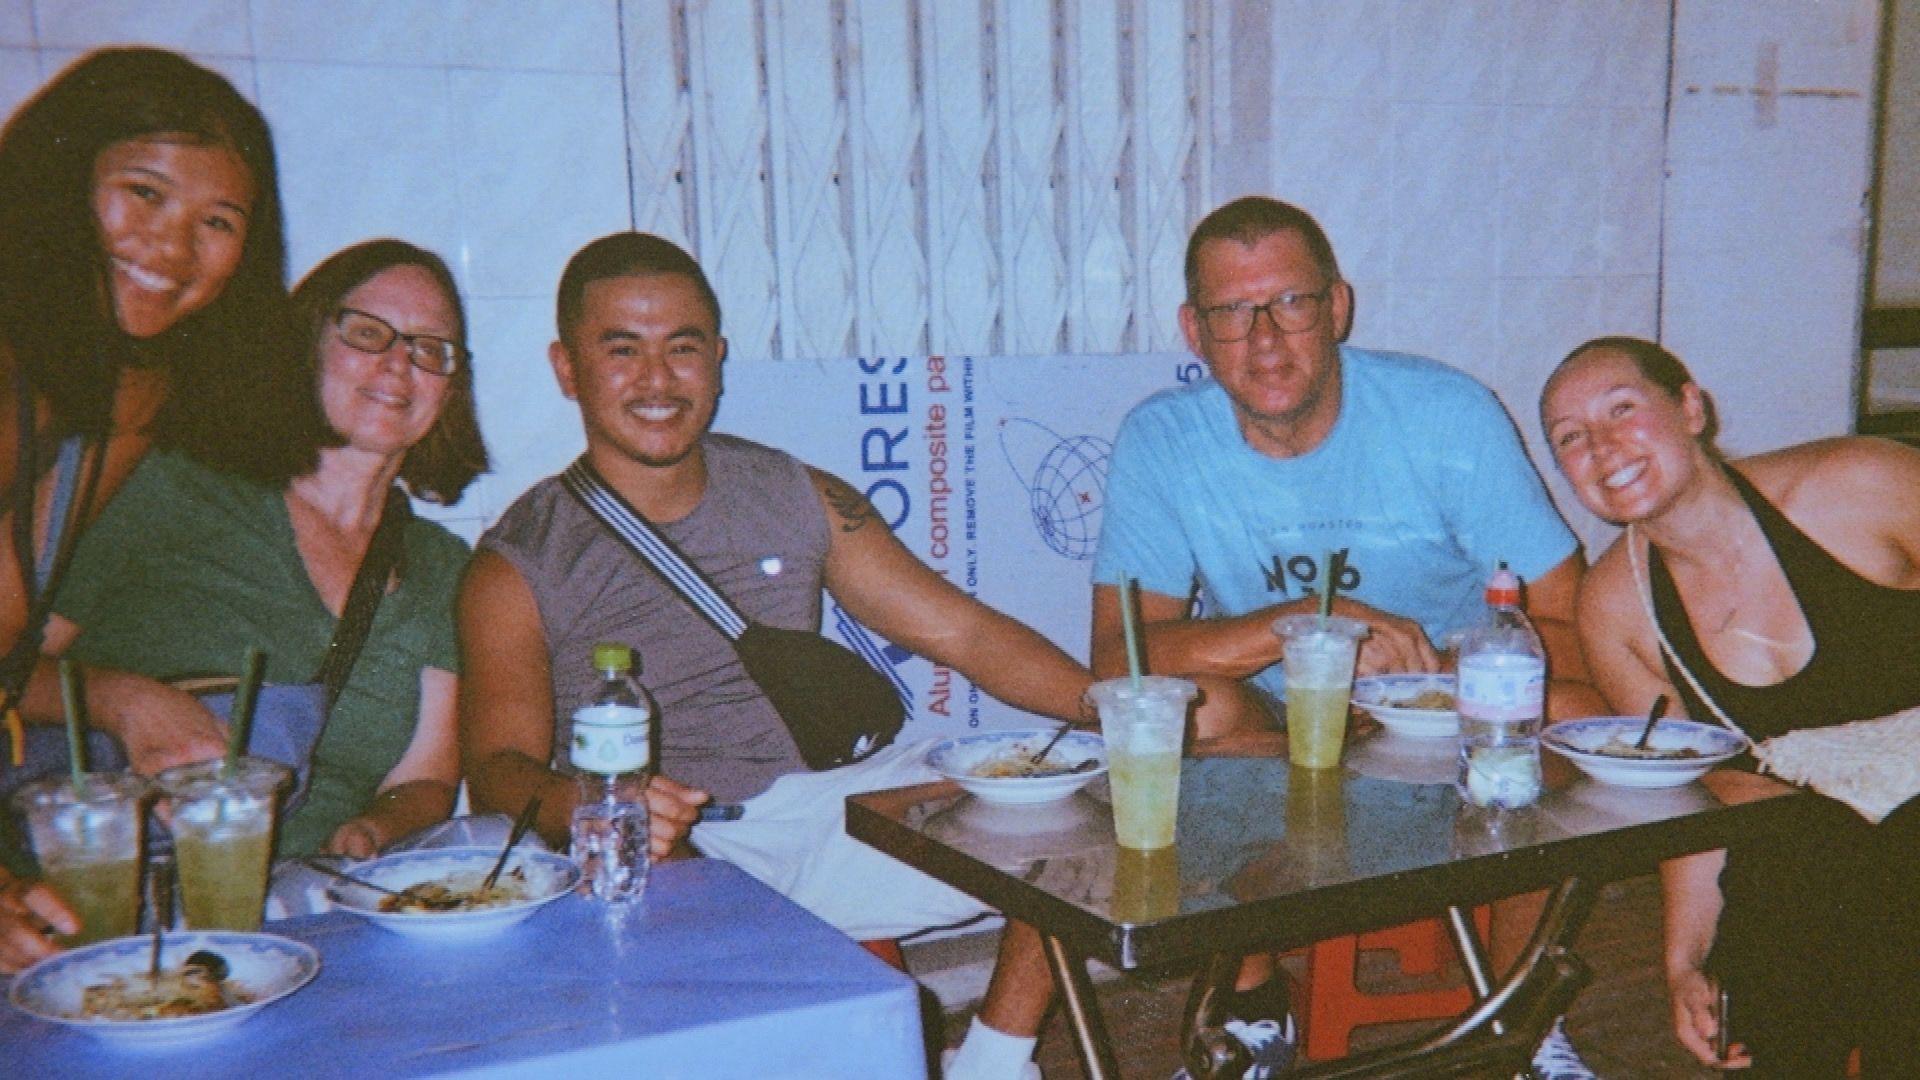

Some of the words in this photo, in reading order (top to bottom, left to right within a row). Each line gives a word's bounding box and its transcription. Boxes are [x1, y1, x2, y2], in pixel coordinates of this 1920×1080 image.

[927, 356, 953, 392] pa
[964, 406, 975, 441] FILM
[964, 445, 976, 475] THE
[923, 404, 953, 559] composite
[965, 479, 977, 541] REMOVE
